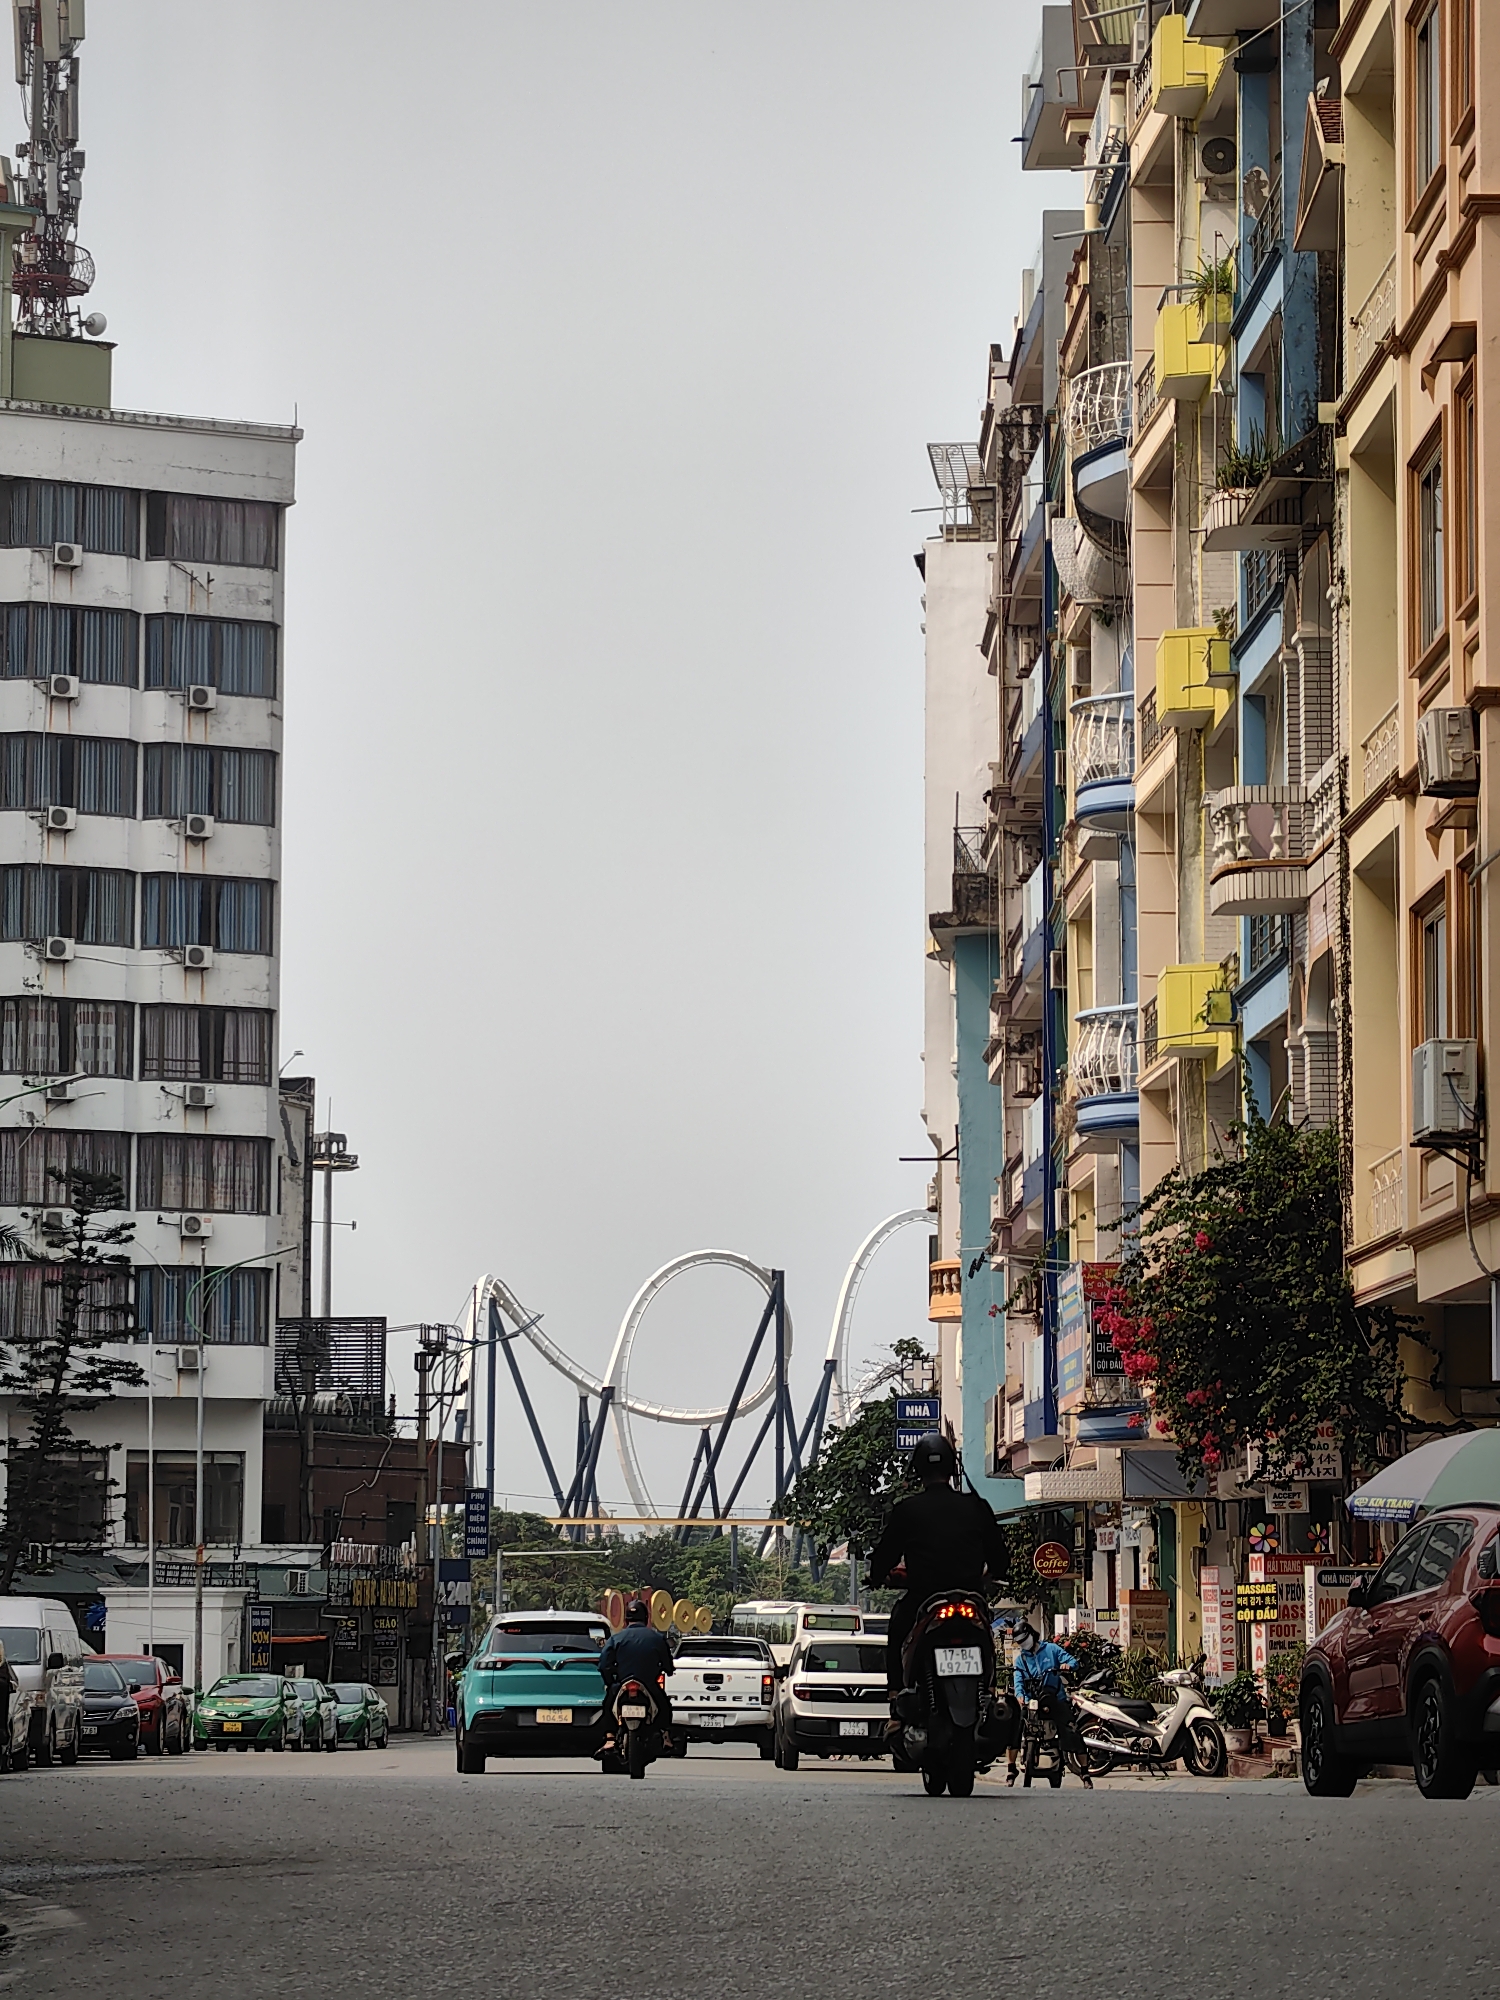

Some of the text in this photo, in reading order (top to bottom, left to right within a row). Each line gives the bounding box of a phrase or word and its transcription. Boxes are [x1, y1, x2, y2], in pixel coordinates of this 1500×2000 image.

[905, 1402, 931, 1417] NHÀ
[899, 1431, 929, 1446] THU
[470, 1492, 485, 1501] PHỤ
[1273, 1492, 1302, 1500] ACCEPT
[469, 1503, 486, 1513] KIỆN
[1368, 1498, 1415, 1509] KIM TRANG
[469, 1514, 486, 1523] ĐIỆN
[467, 1526, 487, 1535] THOẠI
[466, 1536, 487, 1545] CHÍNH
[1036, 1558, 1069, 1569] Coffee
[1266, 1557, 1279, 1572] HẢI
[1280, 1559, 1301, 1572] TRANG
[1321, 1573, 1338, 1584] NHÀ
[1237, 1584, 1277, 1595] MASSAGE
[1237, 1608, 1254, 1622] GỘI
[374, 1616, 397, 1628] CHÁO
[1220, 1589, 1235, 1672] MASSAGE
[942, 1649, 974, 1661] 17-B4
[940, 1661, 980, 1673] 492.71
